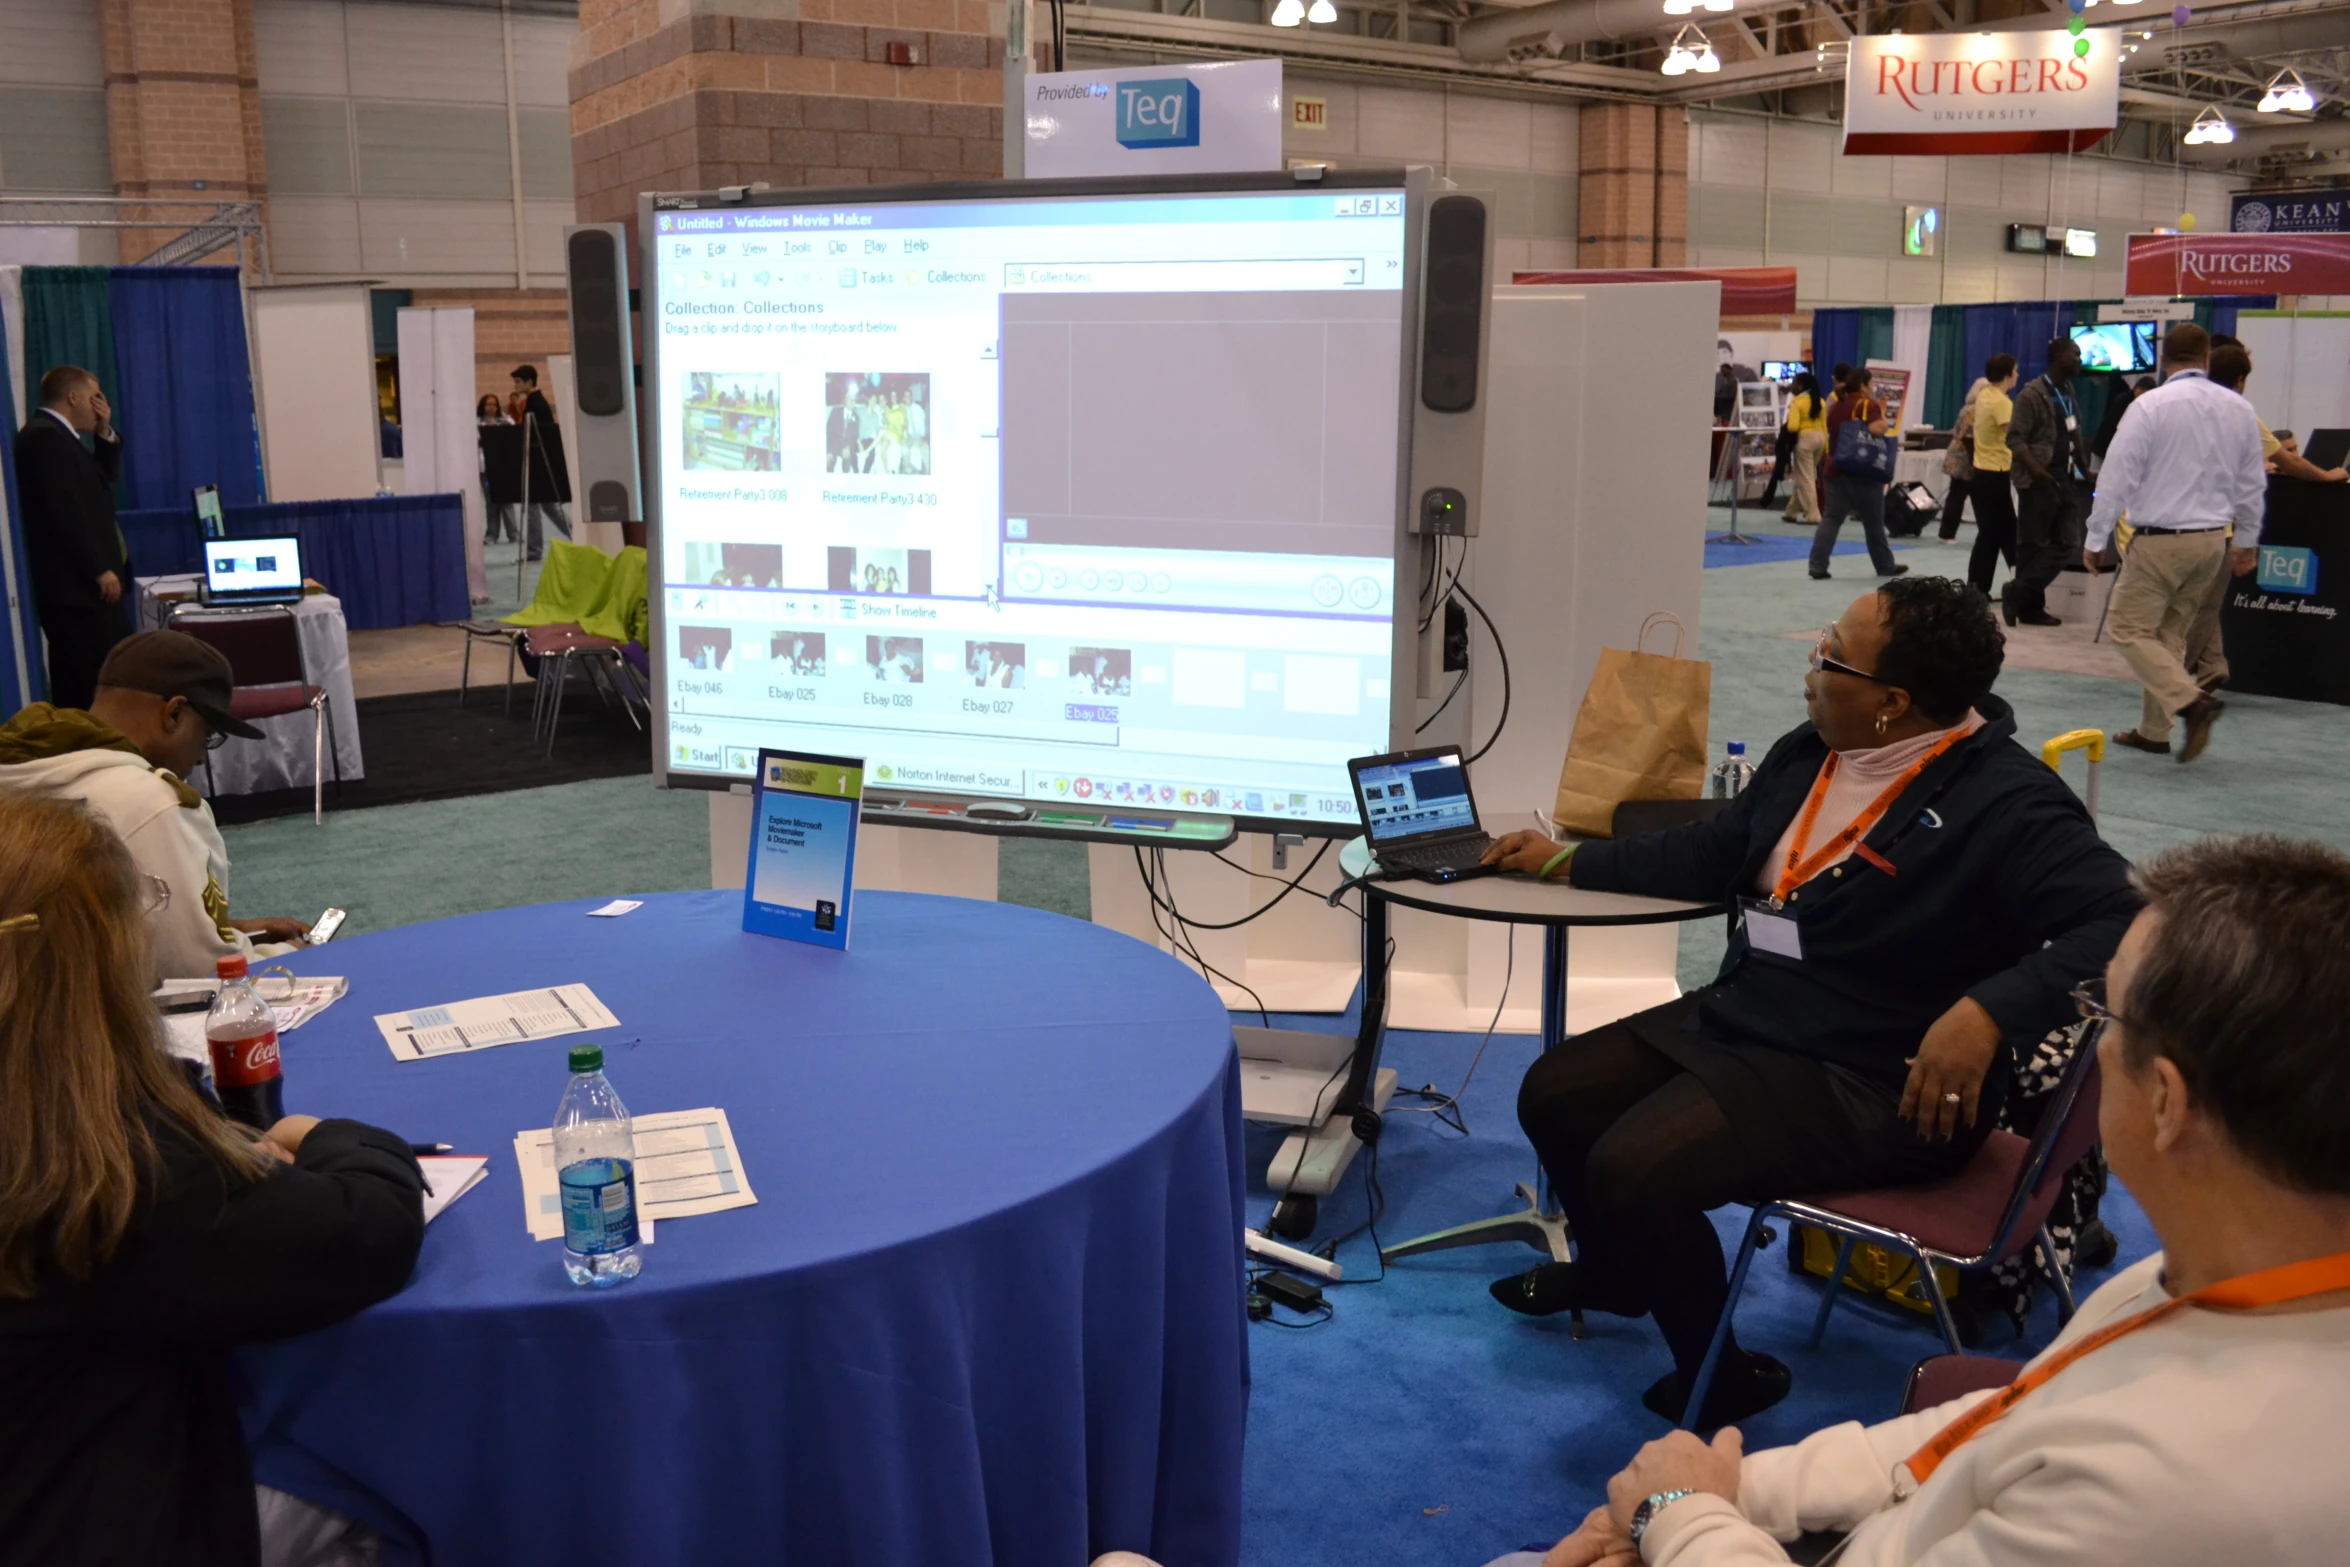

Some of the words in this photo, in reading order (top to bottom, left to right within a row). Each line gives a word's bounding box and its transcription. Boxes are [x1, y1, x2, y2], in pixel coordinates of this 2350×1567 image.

[1875, 54, 2088, 112] RUTGERS
[1037, 83, 1090, 100] Provided
[1121, 88, 1182, 135] Teq
[1296, 102, 1323, 124] EXIT
[1934, 109, 2037, 120] UNIVERSITY
[2275, 202, 2341, 219] KEAN
[678, 215, 723, 230] Untitled
[734, 214, 789, 228] Windows
[793, 213, 830, 227] Movie
[833, 213, 872, 226] Maker
[675, 243, 692, 257] File
[708, 243, 726, 256] Edit
[742, 243, 767, 256] View
[784, 241, 811, 255] Tools
[828, 240, 848, 254] Clip
[864, 239, 887, 254] Play
[904, 238, 929, 253] Help
[2182, 250, 2291, 282] RUTGERS
[862, 271, 893, 284] Tasks
[927, 270, 986, 283] Collections
[1031, 270, 1091, 284] Collections
[743, 300, 824, 314] Collections
[665, 321, 689, 336] Drag
[693, 325, 699, 334] a
[701, 321, 718, 335] clip
[721, 321, 739, 333] and
[742, 321, 764, 335] drop
[775, 324, 788, 333] on
[791, 321, 807, 333] the
[811, 320, 863, 335] storyboard
[679, 487, 731, 500] Retirement
[734, 488, 766, 502] Party3
[767, 489, 787, 502] 008
[822, 490, 878, 504] Retirement
[880, 492, 914, 506] Party3
[917, 493, 937, 506] 430
[2263, 549, 2305, 586] Teq
[862, 603, 891, 616] Show
[895, 604, 937, 618] Timeline
[2234, 593, 2249, 609] It's
[2250, 596, 2268, 610] all
[2267, 599, 2296, 612] about
[678, 679, 702, 695] Ebay
[704, 682, 723, 695] 046
[768, 686, 793, 702] Ebay
[796, 688, 816, 701] 025
[863, 692, 889, 707] Ebay
[892, 694, 912, 707] 028
[962, 698, 990, 714] Ebay
[993, 701, 1013, 714] 027
[1066, 704, 1095, 722] Ebay
[1097, 707, 1119, 722] 025
[671, 720, 702, 736] Ready
[692, 748, 719, 763] Start
[898, 766, 933, 781] Norton
[936, 770, 976, 784] Internet
[838, 775, 846, 794] 1
[1318, 799, 1352, 814] 10:50
[768, 815, 792, 827] Explore
[793, 818, 822, 831] Microsoft
[768, 825, 805, 837] Moviemaker
[773, 835, 805, 847] Document
